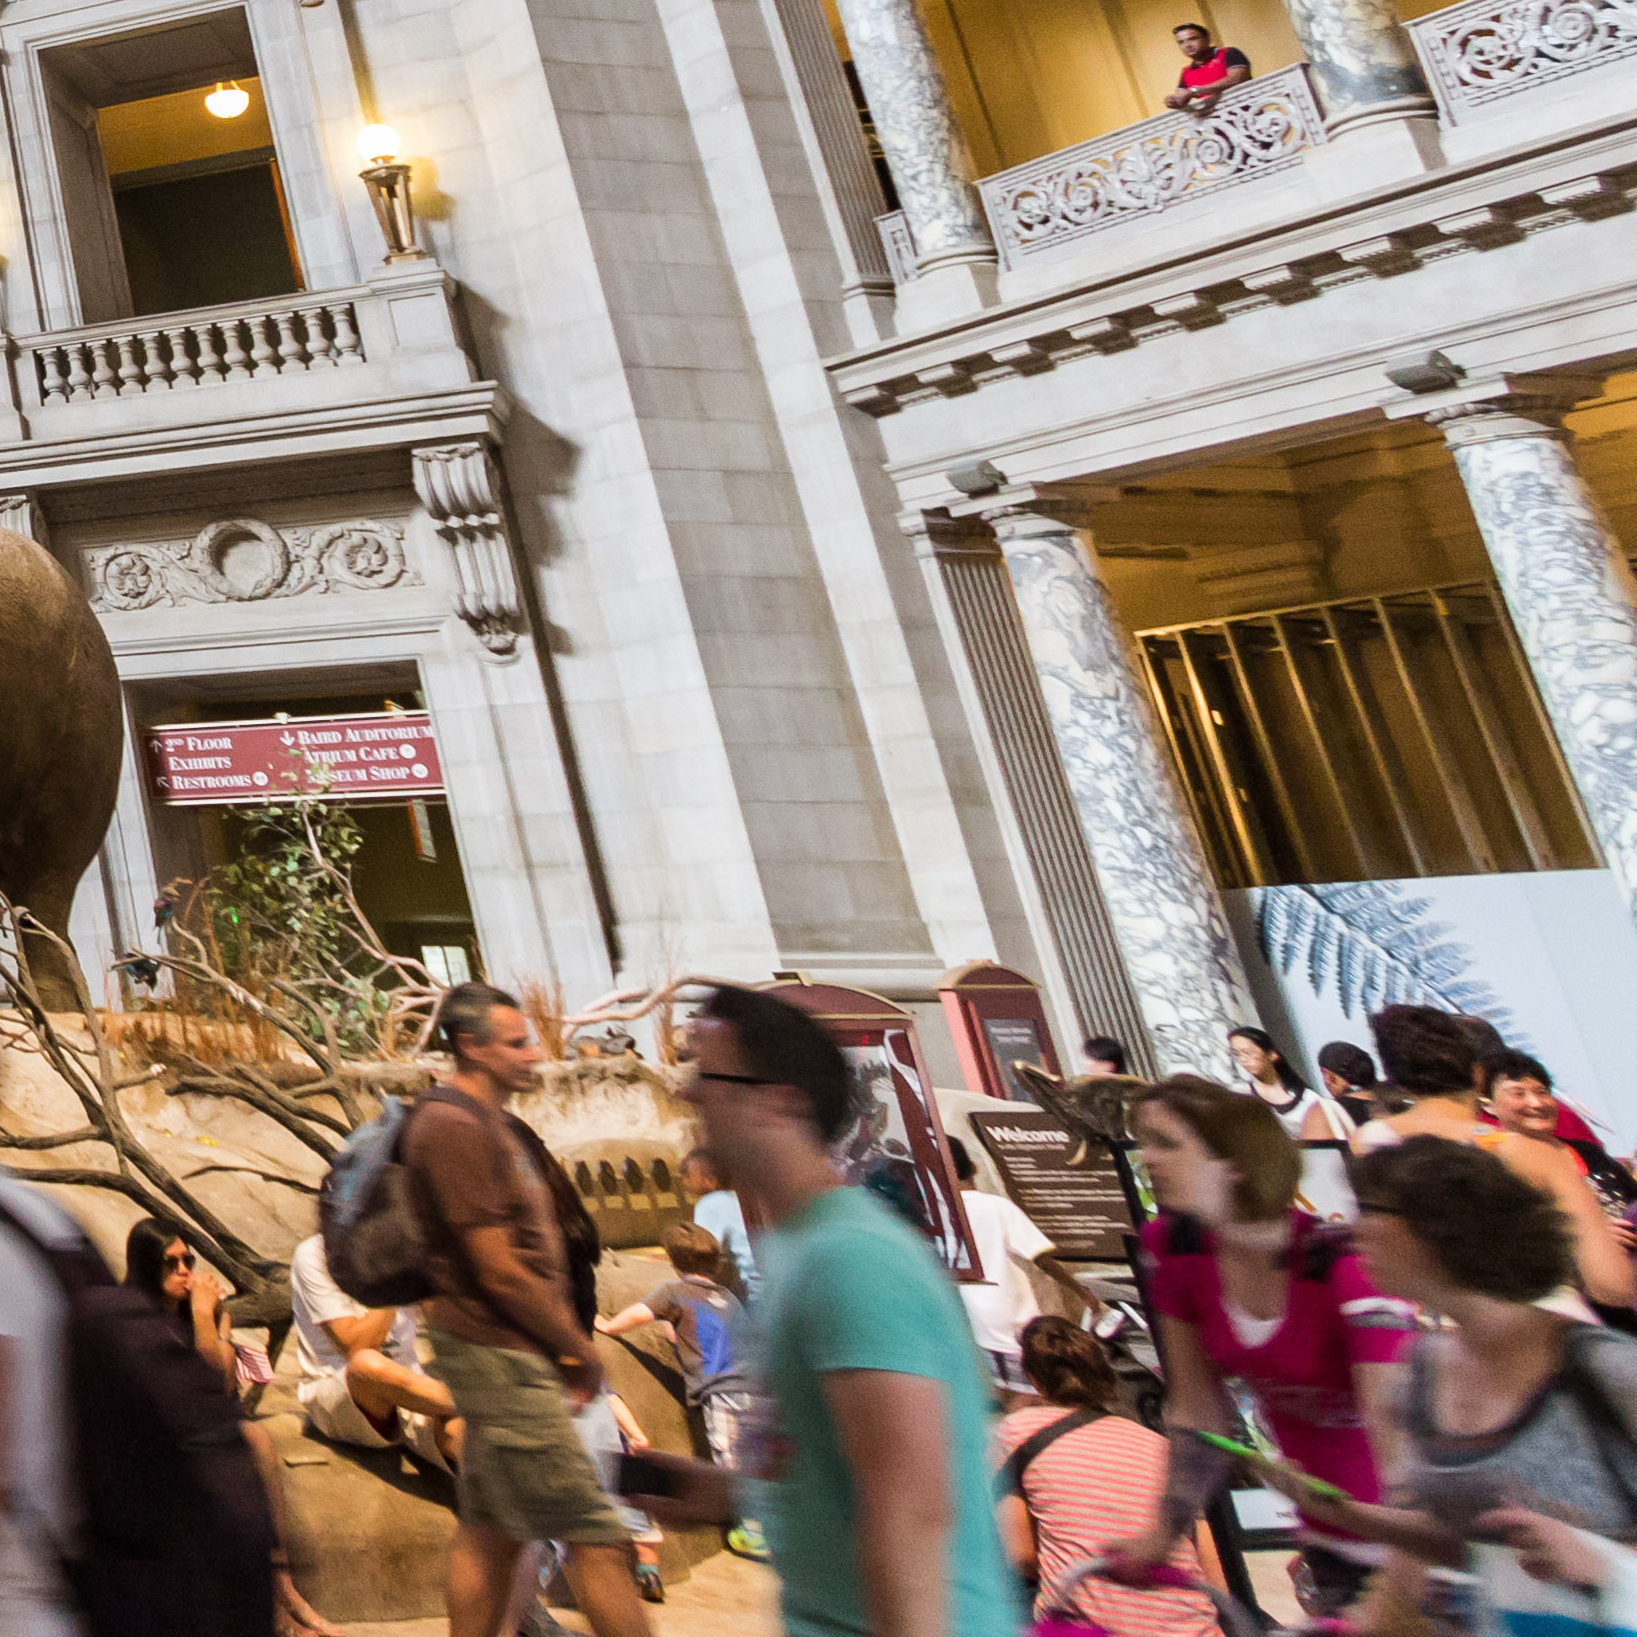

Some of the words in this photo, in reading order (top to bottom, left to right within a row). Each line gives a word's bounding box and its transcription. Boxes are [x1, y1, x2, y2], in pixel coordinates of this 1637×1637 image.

[298, 730, 341, 745] BAIRD
[345, 725, 434, 743] AUDITORIUM
[187, 736, 232, 751] FLOOR
[168, 757, 232, 771] EXHIBITS
[303, 748, 357, 764] ATRIUM
[370, 765, 411, 781] SHOP
[173, 774, 252, 790] RESTROOMS
[985, 1125, 1070, 1143] Welcome
